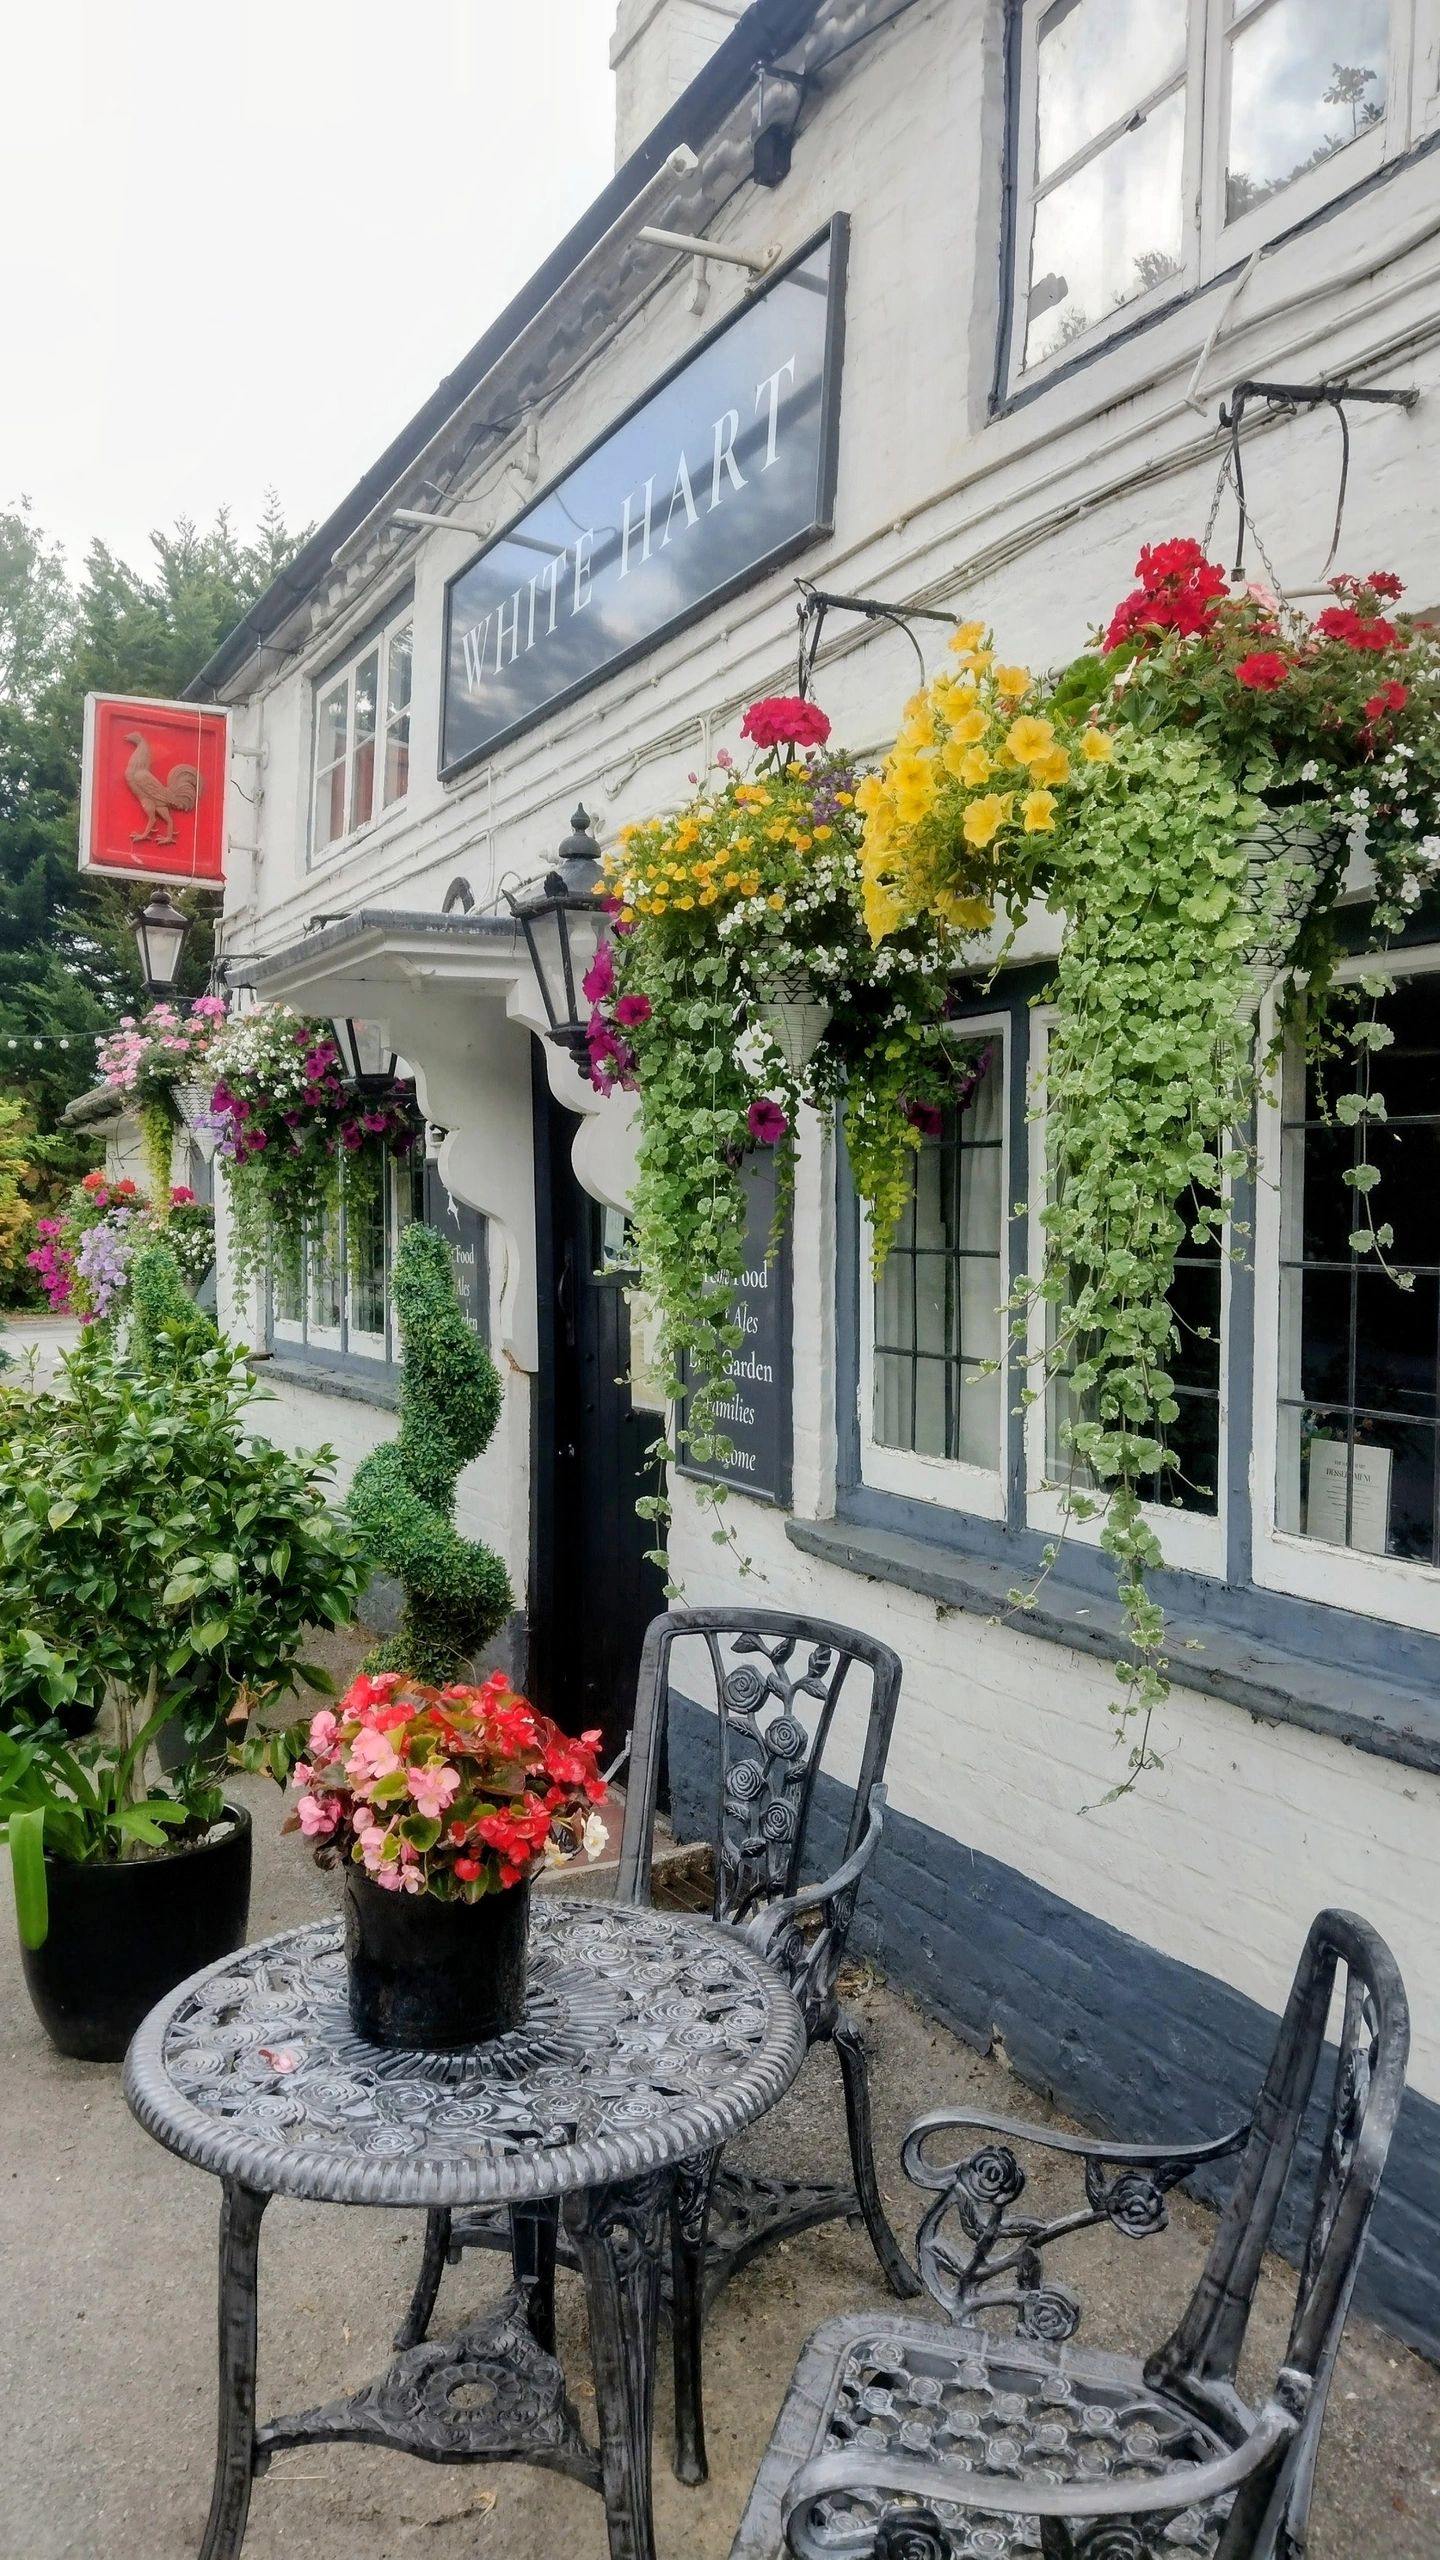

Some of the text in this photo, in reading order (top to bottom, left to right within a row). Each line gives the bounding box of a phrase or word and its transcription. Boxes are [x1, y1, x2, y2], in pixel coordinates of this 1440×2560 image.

[461, 354, 796, 695] WHITE HART
[455, 1243, 474, 1264] Food
[456, 1275, 470, 1296] Ales
[732, 1304, 759, 1334] Ales
[721, 1349, 774, 1383] Garden
